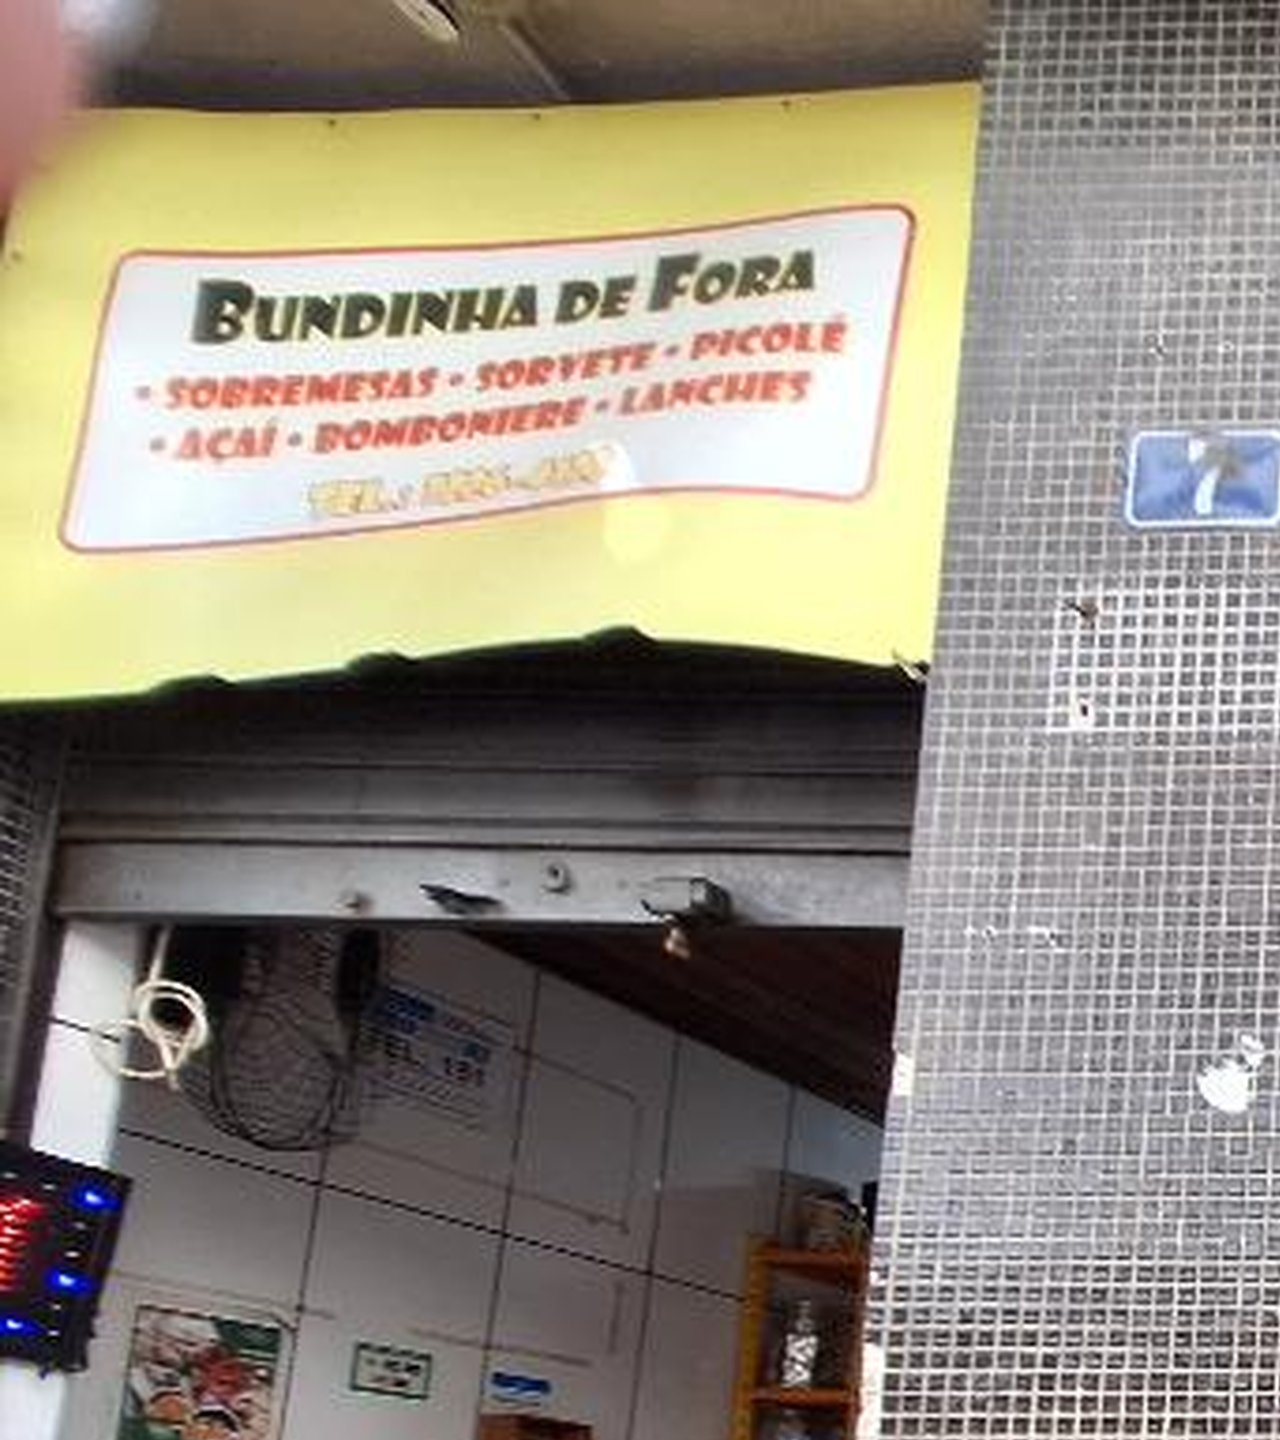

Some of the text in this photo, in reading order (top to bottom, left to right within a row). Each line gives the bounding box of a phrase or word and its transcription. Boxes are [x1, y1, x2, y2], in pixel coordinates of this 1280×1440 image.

[191, 250, 815, 345] BUNDINHA DE FORA
[166, 367, 439, 410] SOBREMESAS
[476, 342, 656, 392] SORVETE
[176, 371, 812, 463] AÇAÍ BOMBONIERE LANCHES
[1186, 436, 1242, 516] 7
